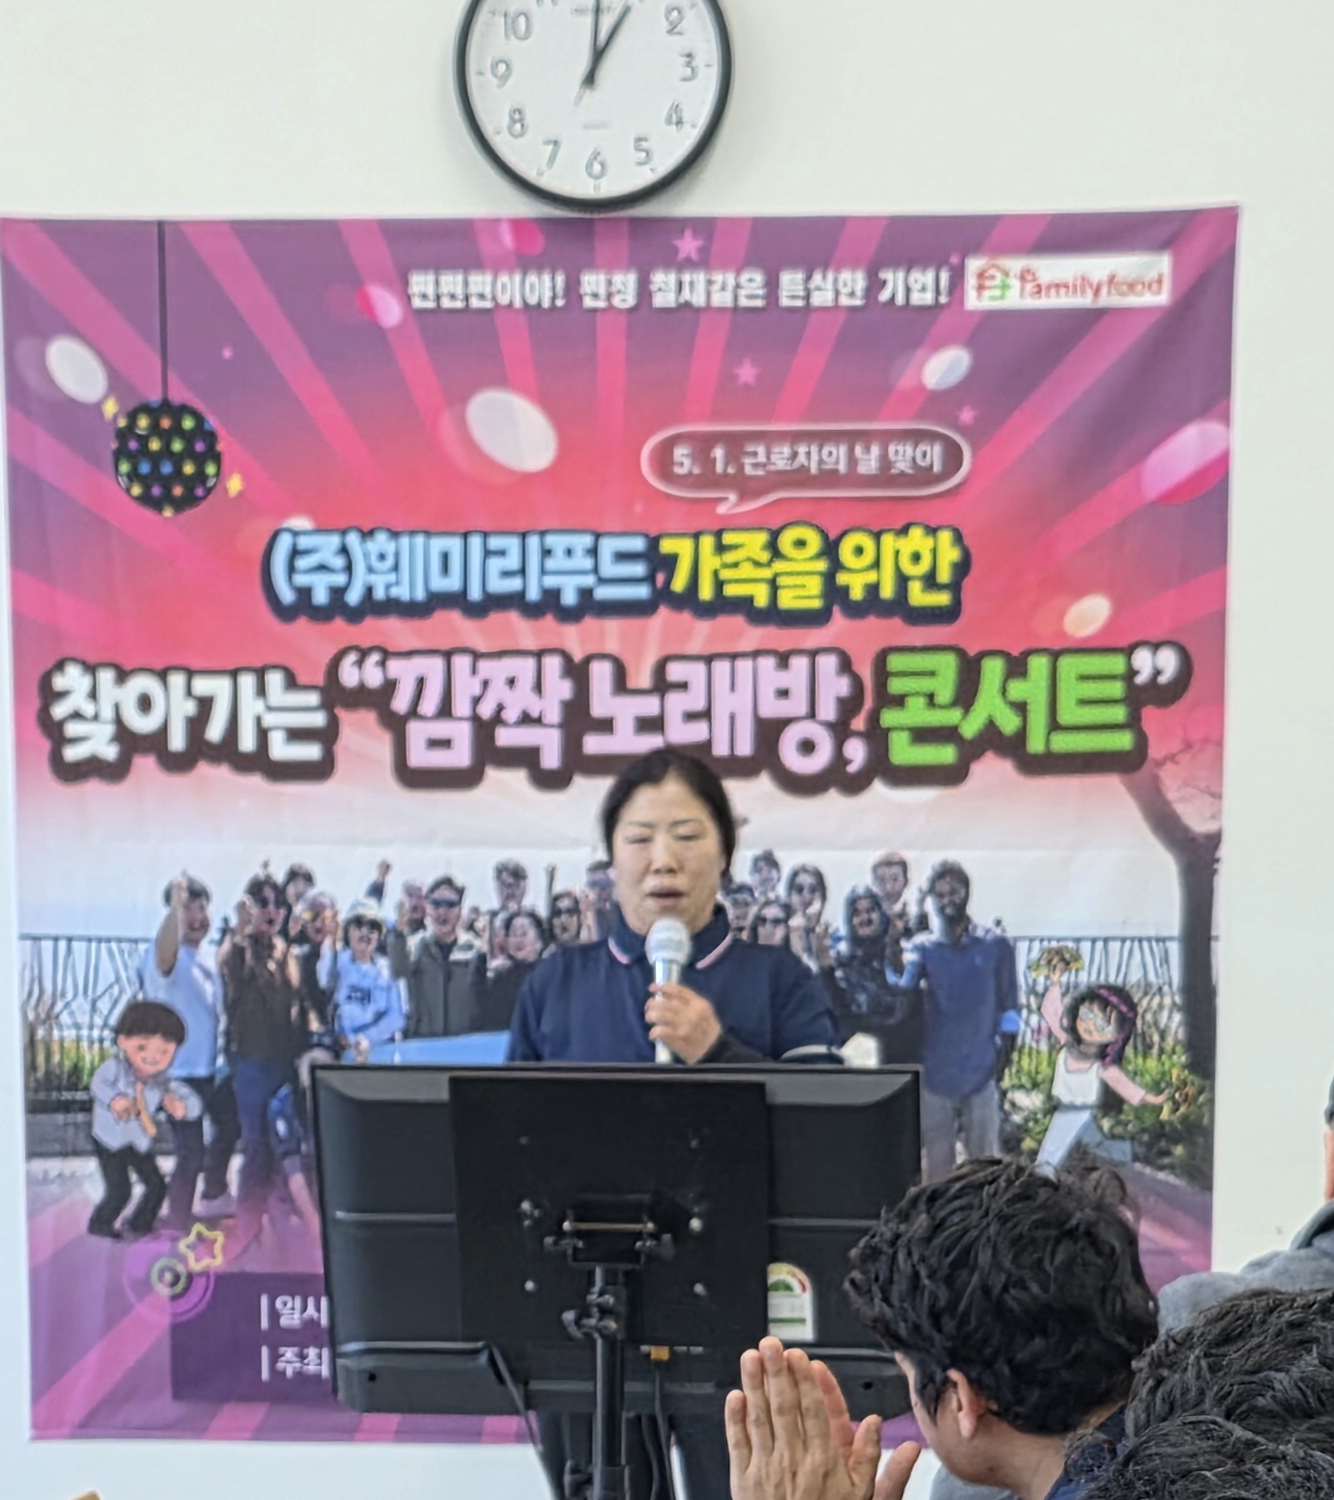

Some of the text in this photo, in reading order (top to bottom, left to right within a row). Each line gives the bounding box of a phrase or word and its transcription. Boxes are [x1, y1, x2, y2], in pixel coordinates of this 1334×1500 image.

[503, 11, 533, 40] 10
[664, 6, 684, 36] 2
[490, 57, 512, 88] 9
[679, 51, 698, 81] 3
[507, 106, 529, 138] 8
[664, 101, 685, 131] 4
[542, 139, 561, 169] 7
[584, 148, 607, 180] 6
[633, 137, 653, 166] 5
[878, 267, 950, 306] 기업!
[673, 440, 944, 475] 5. 1. 근로자의 날 맞이
[269, 523, 962, 610] (주)훼미리푸드 가족을 위한
[50, 647, 1179, 774] 찾아가는 “깜짝 노래방, 콘서트”
[275, 1295, 329, 1329] 일시
[276, 1346, 330, 1379] 주최
